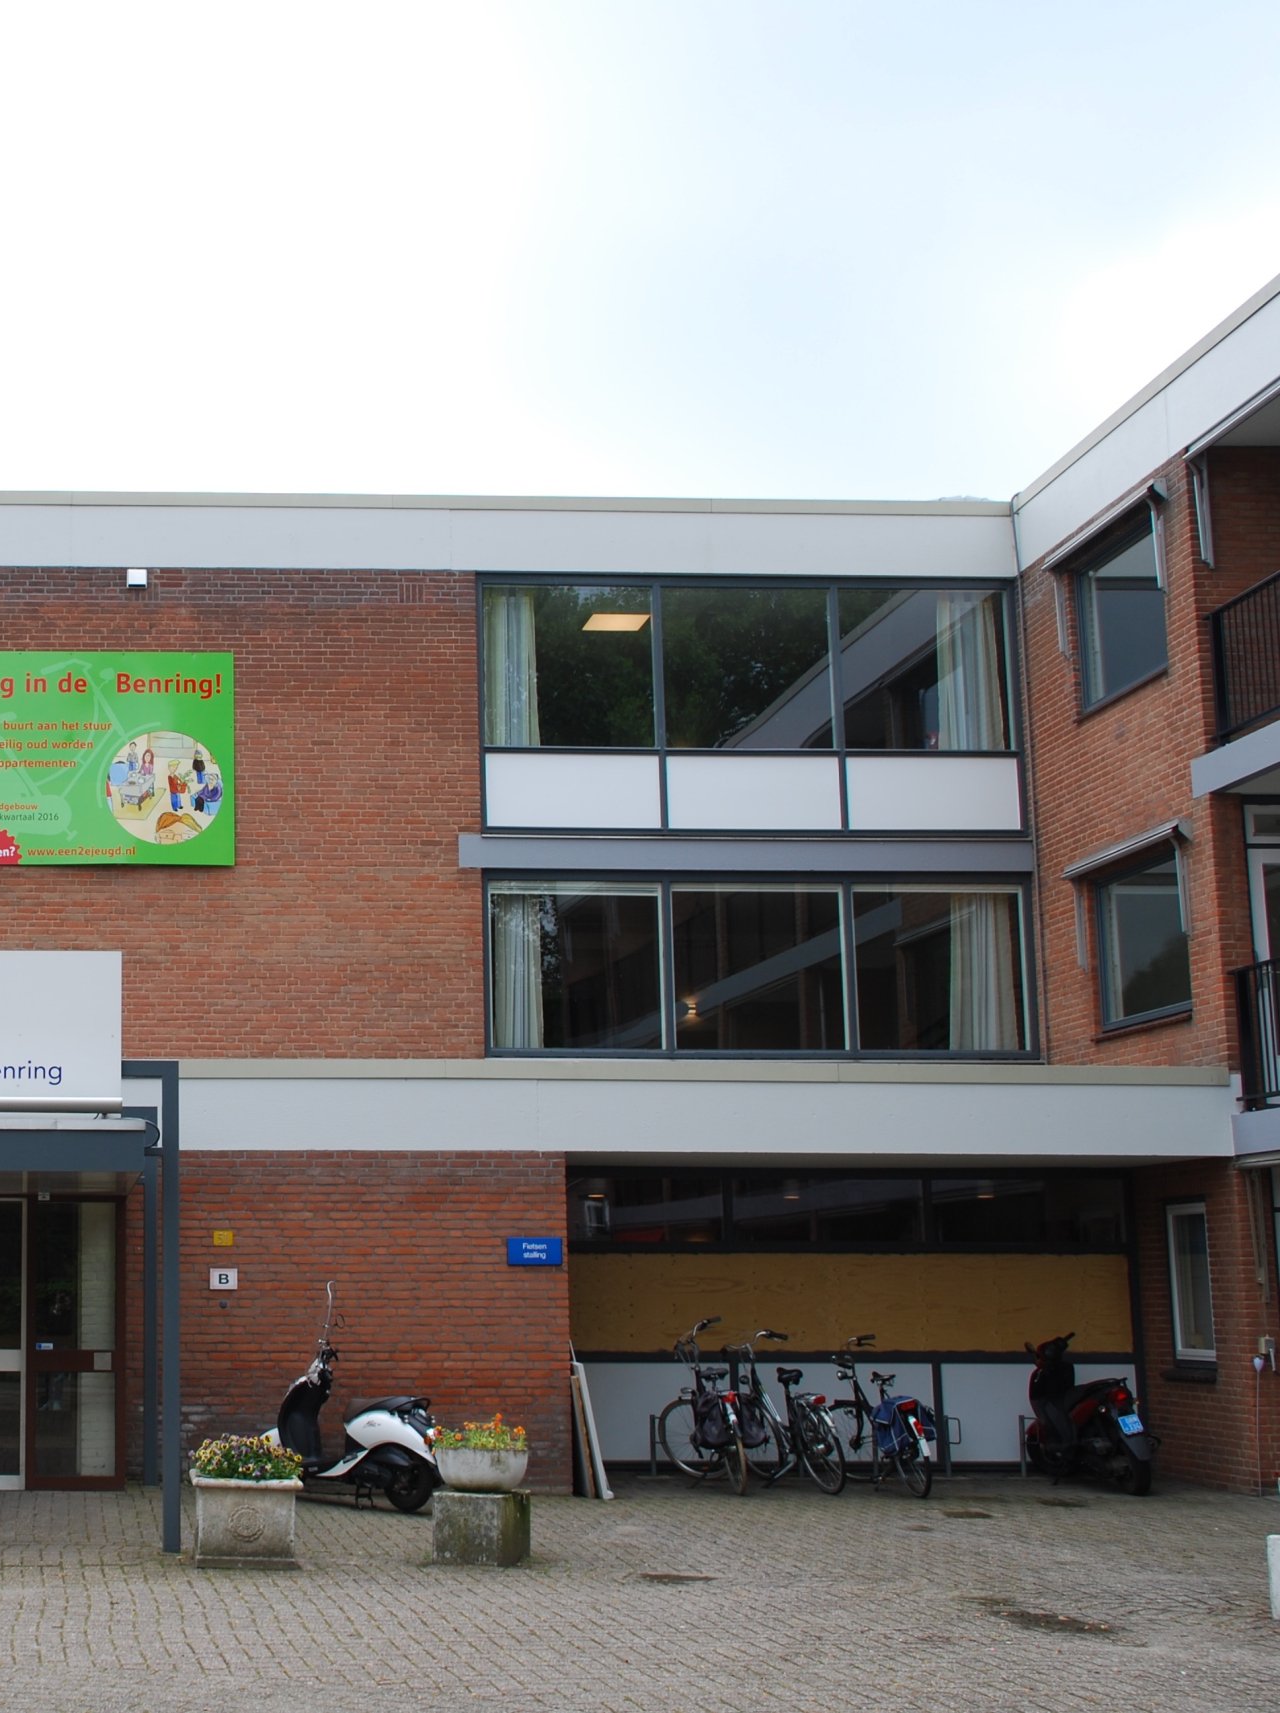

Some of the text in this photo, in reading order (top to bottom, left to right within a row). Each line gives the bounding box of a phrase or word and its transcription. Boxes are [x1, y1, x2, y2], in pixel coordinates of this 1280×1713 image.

[25, 672, 47, 693] in
[58, 672, 87, 693] de
[116, 673, 221, 699] Benring!
[3, 720, 34, 730] buurt
[37, 722, 58, 730] aan
[61, 720, 79, 730] het
[83, 721, 112, 730] stuur
[26, 739, 48, 749] oud
[52, 739, 93, 749] worden
[0, 812, 35, 821] kwartaal
[38, 812, 59, 821] 2016
[27, 846, 136, 857] www.een2ejeugd.nl
[522, 1242, 547, 1250] Fietsen
[523, 1251, 546, 1260] stalling
[218, 1273, 230, 1285] B
